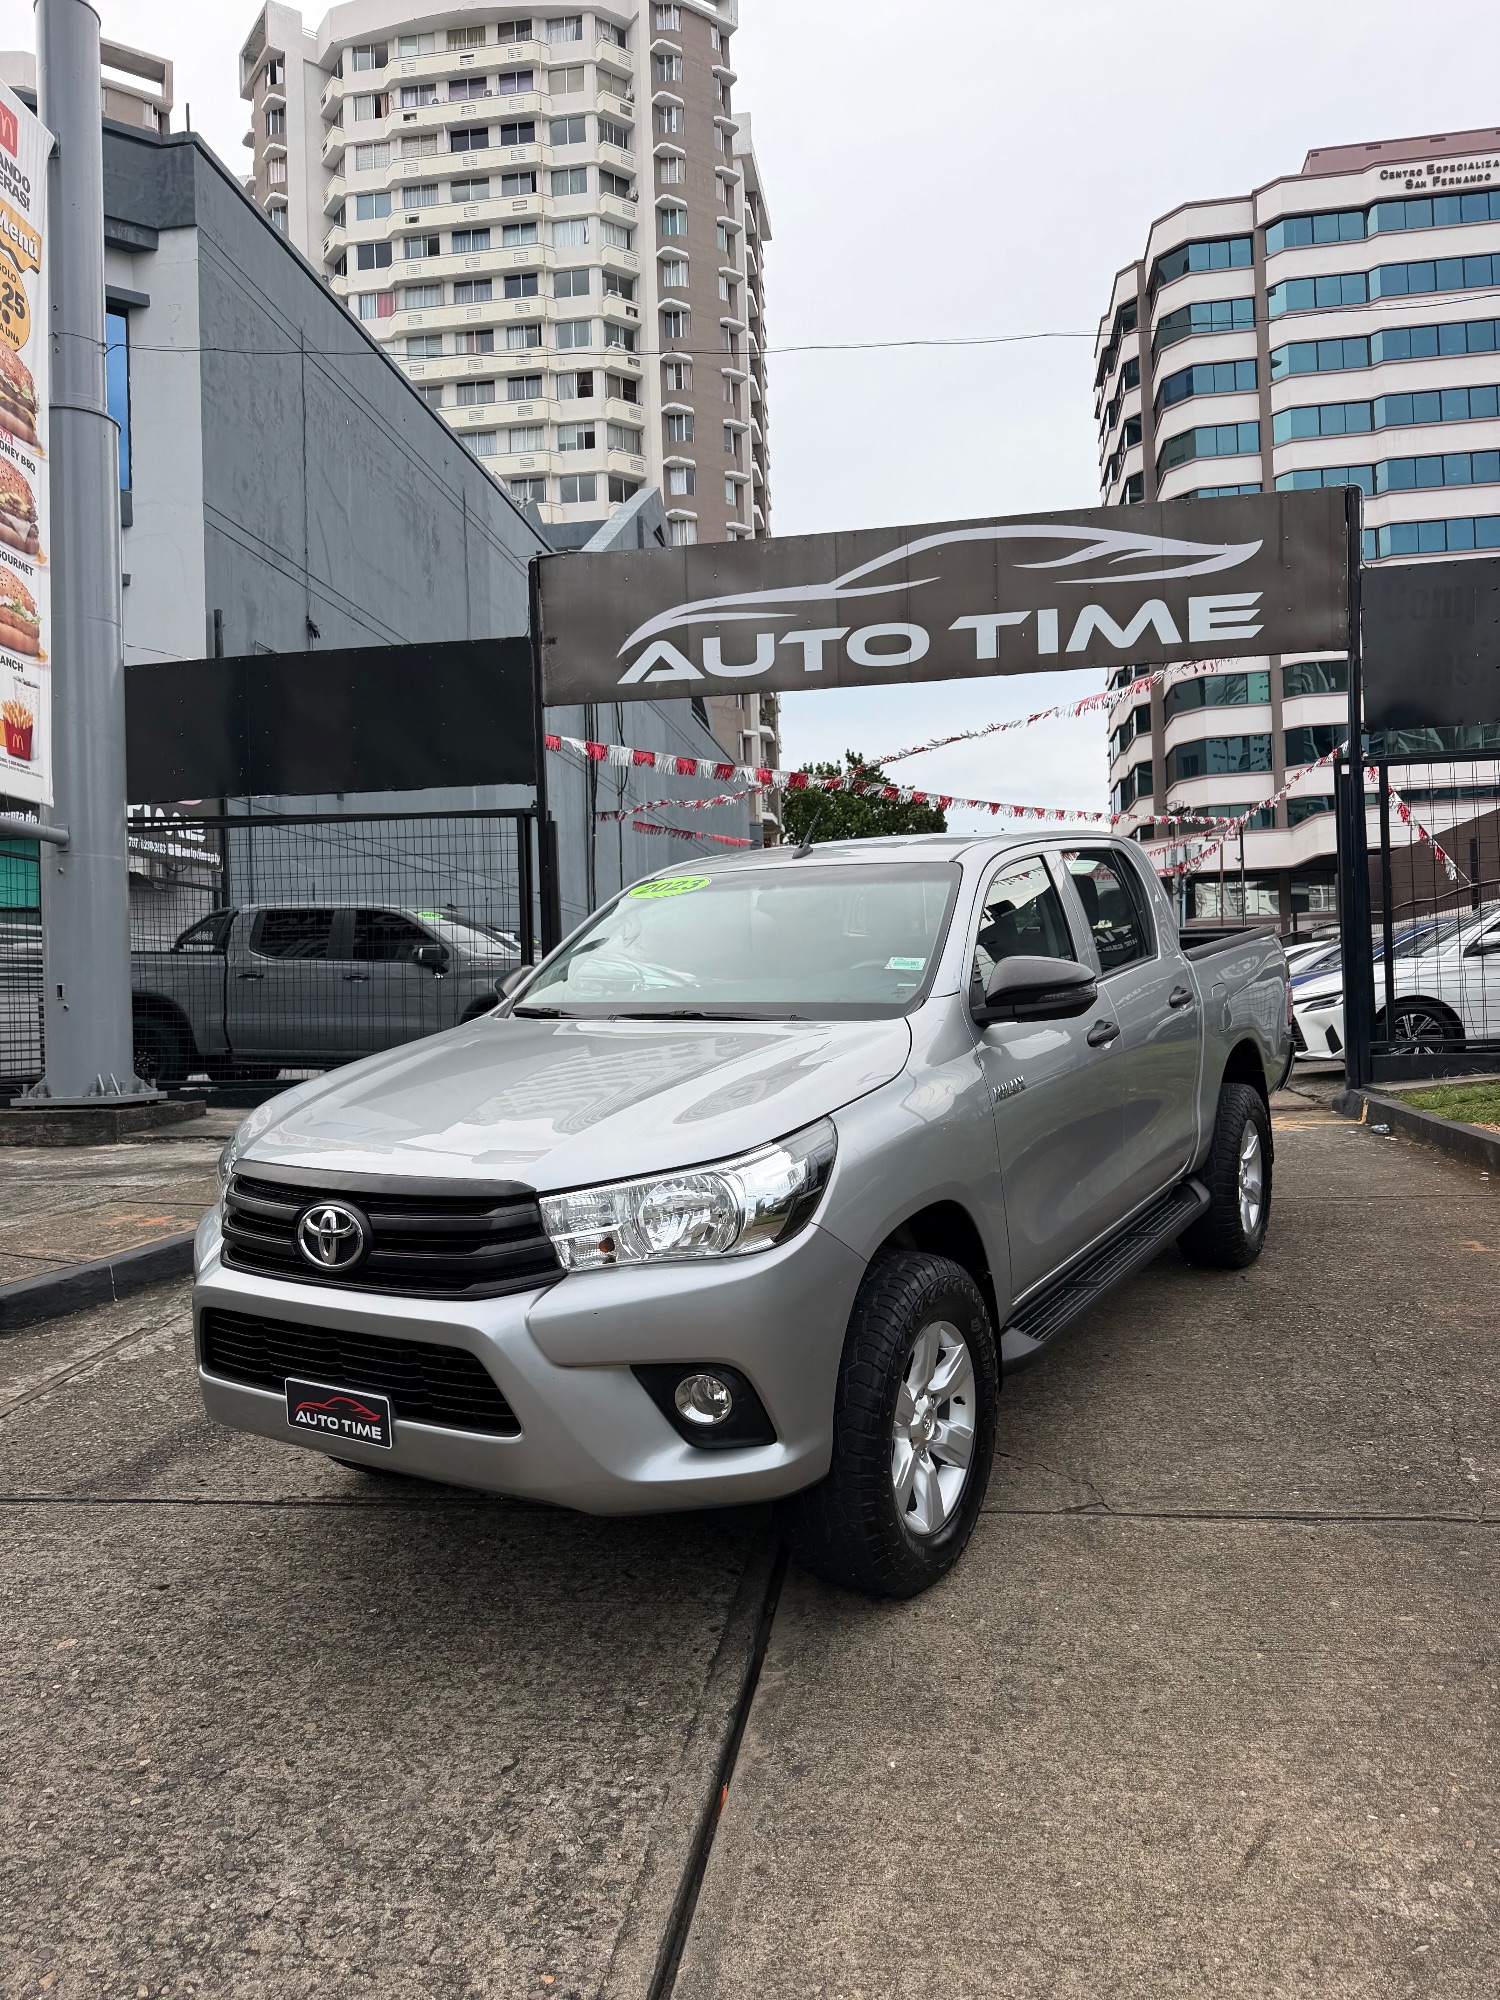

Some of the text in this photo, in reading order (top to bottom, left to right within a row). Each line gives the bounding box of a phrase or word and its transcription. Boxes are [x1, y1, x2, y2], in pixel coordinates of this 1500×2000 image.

[1380, 168, 1423, 181] CENTRO
[1405, 172, 1492, 190] SAN FERNANDO
[0, 262, 17, 284] OLO
[20, 454, 36, 475] BBQ
[0, 550, 34, 577] OURMET
[616, 591, 1265, 685] AUTO TIME
[633, 879, 705, 896] 2023
[295, 1410, 382, 1440] AUTO TIME
